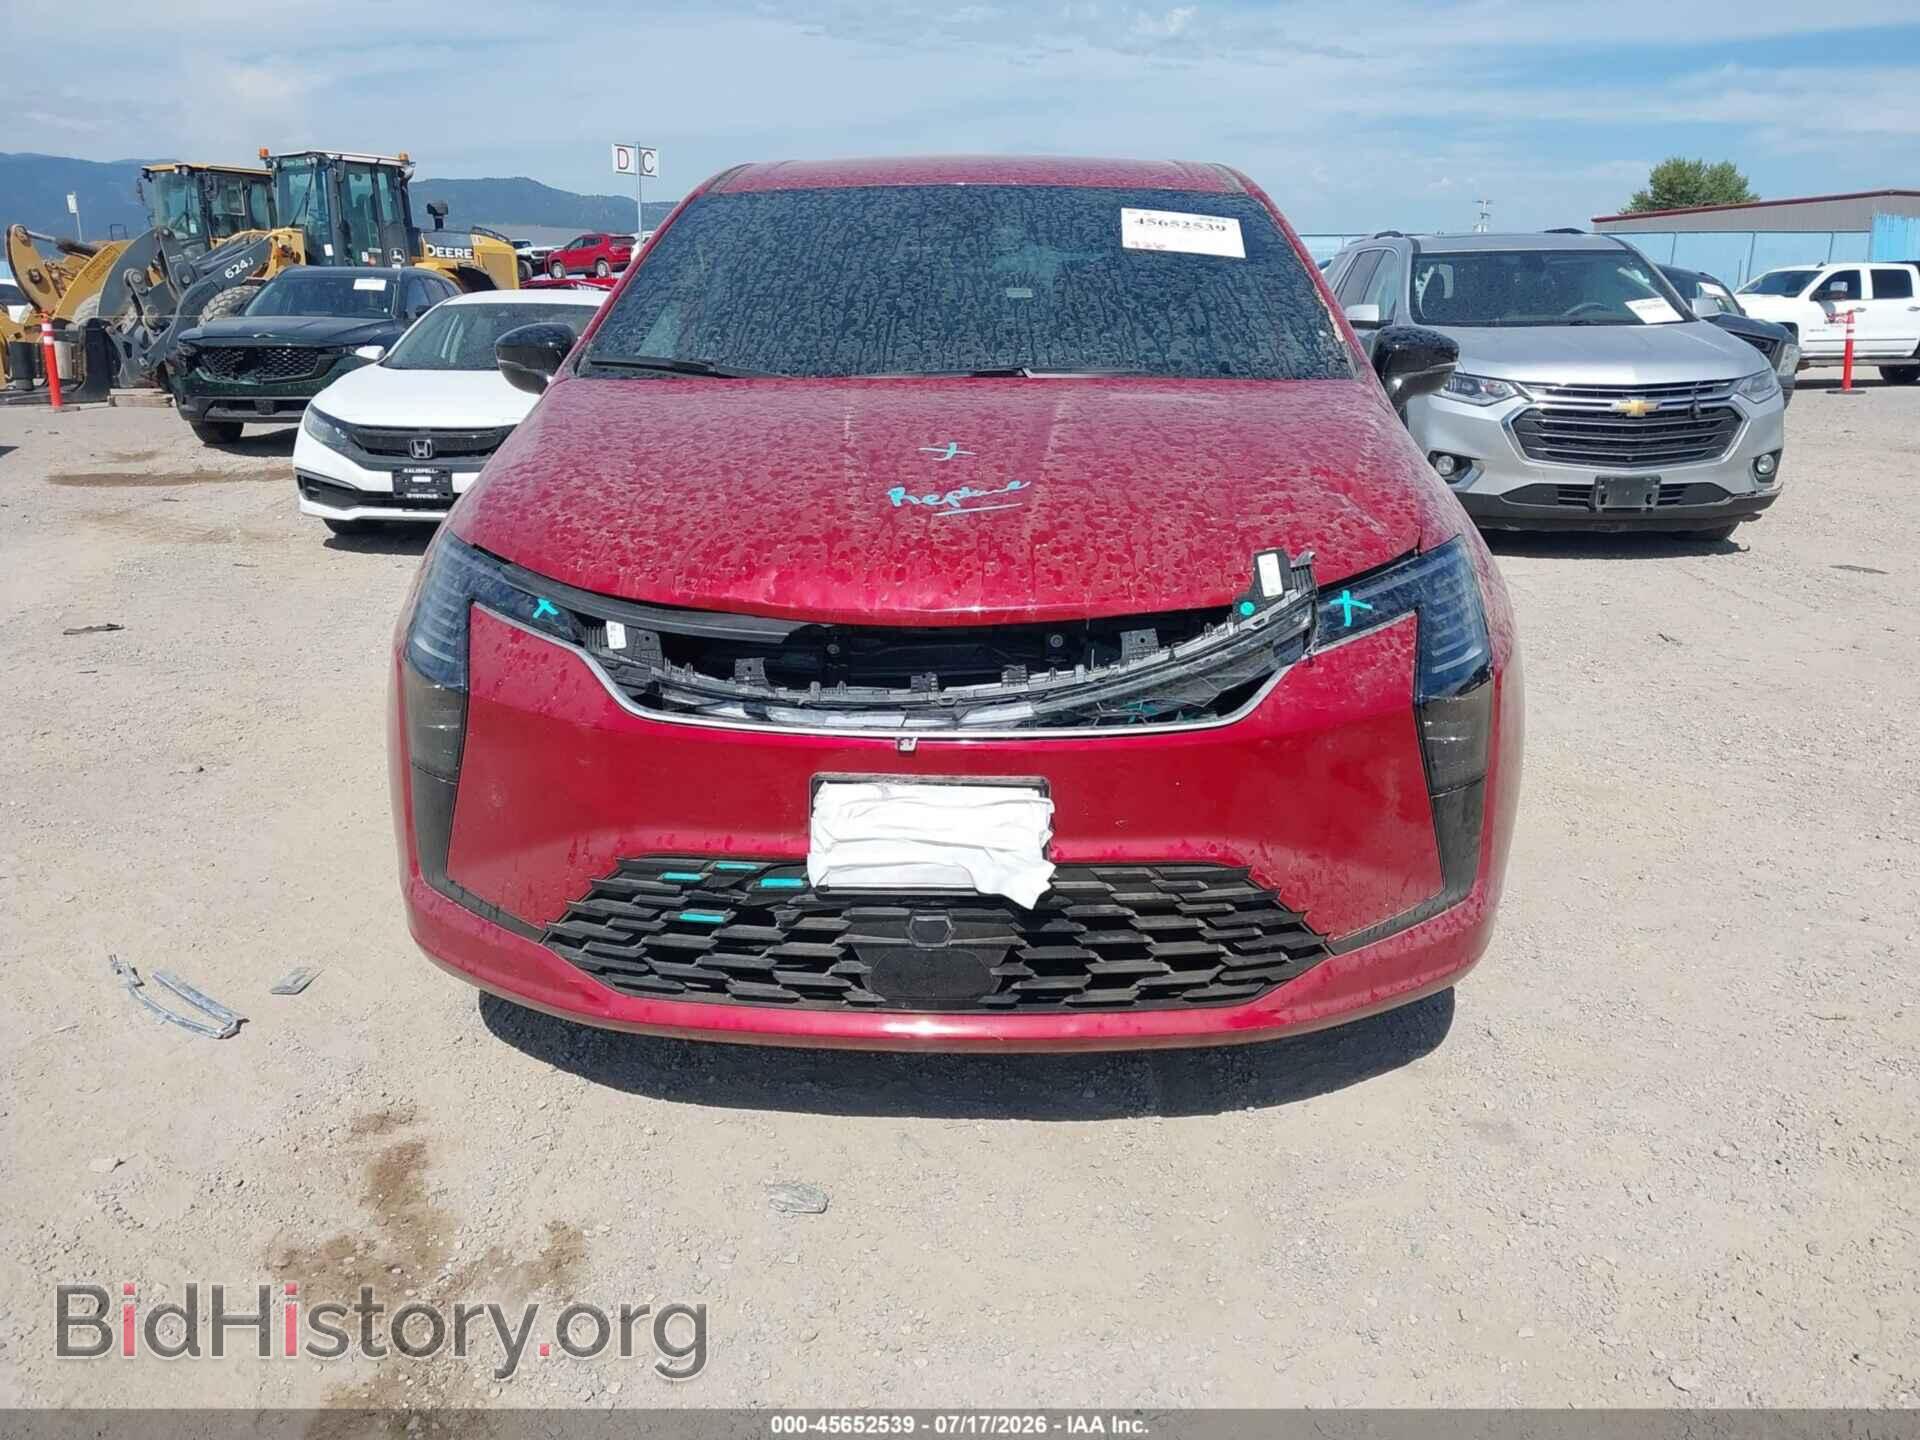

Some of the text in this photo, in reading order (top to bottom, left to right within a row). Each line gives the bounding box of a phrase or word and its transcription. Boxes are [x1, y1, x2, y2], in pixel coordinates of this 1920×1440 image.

[617, 148, 655, 174] D C
[425, 244, 473, 259] DEERE
